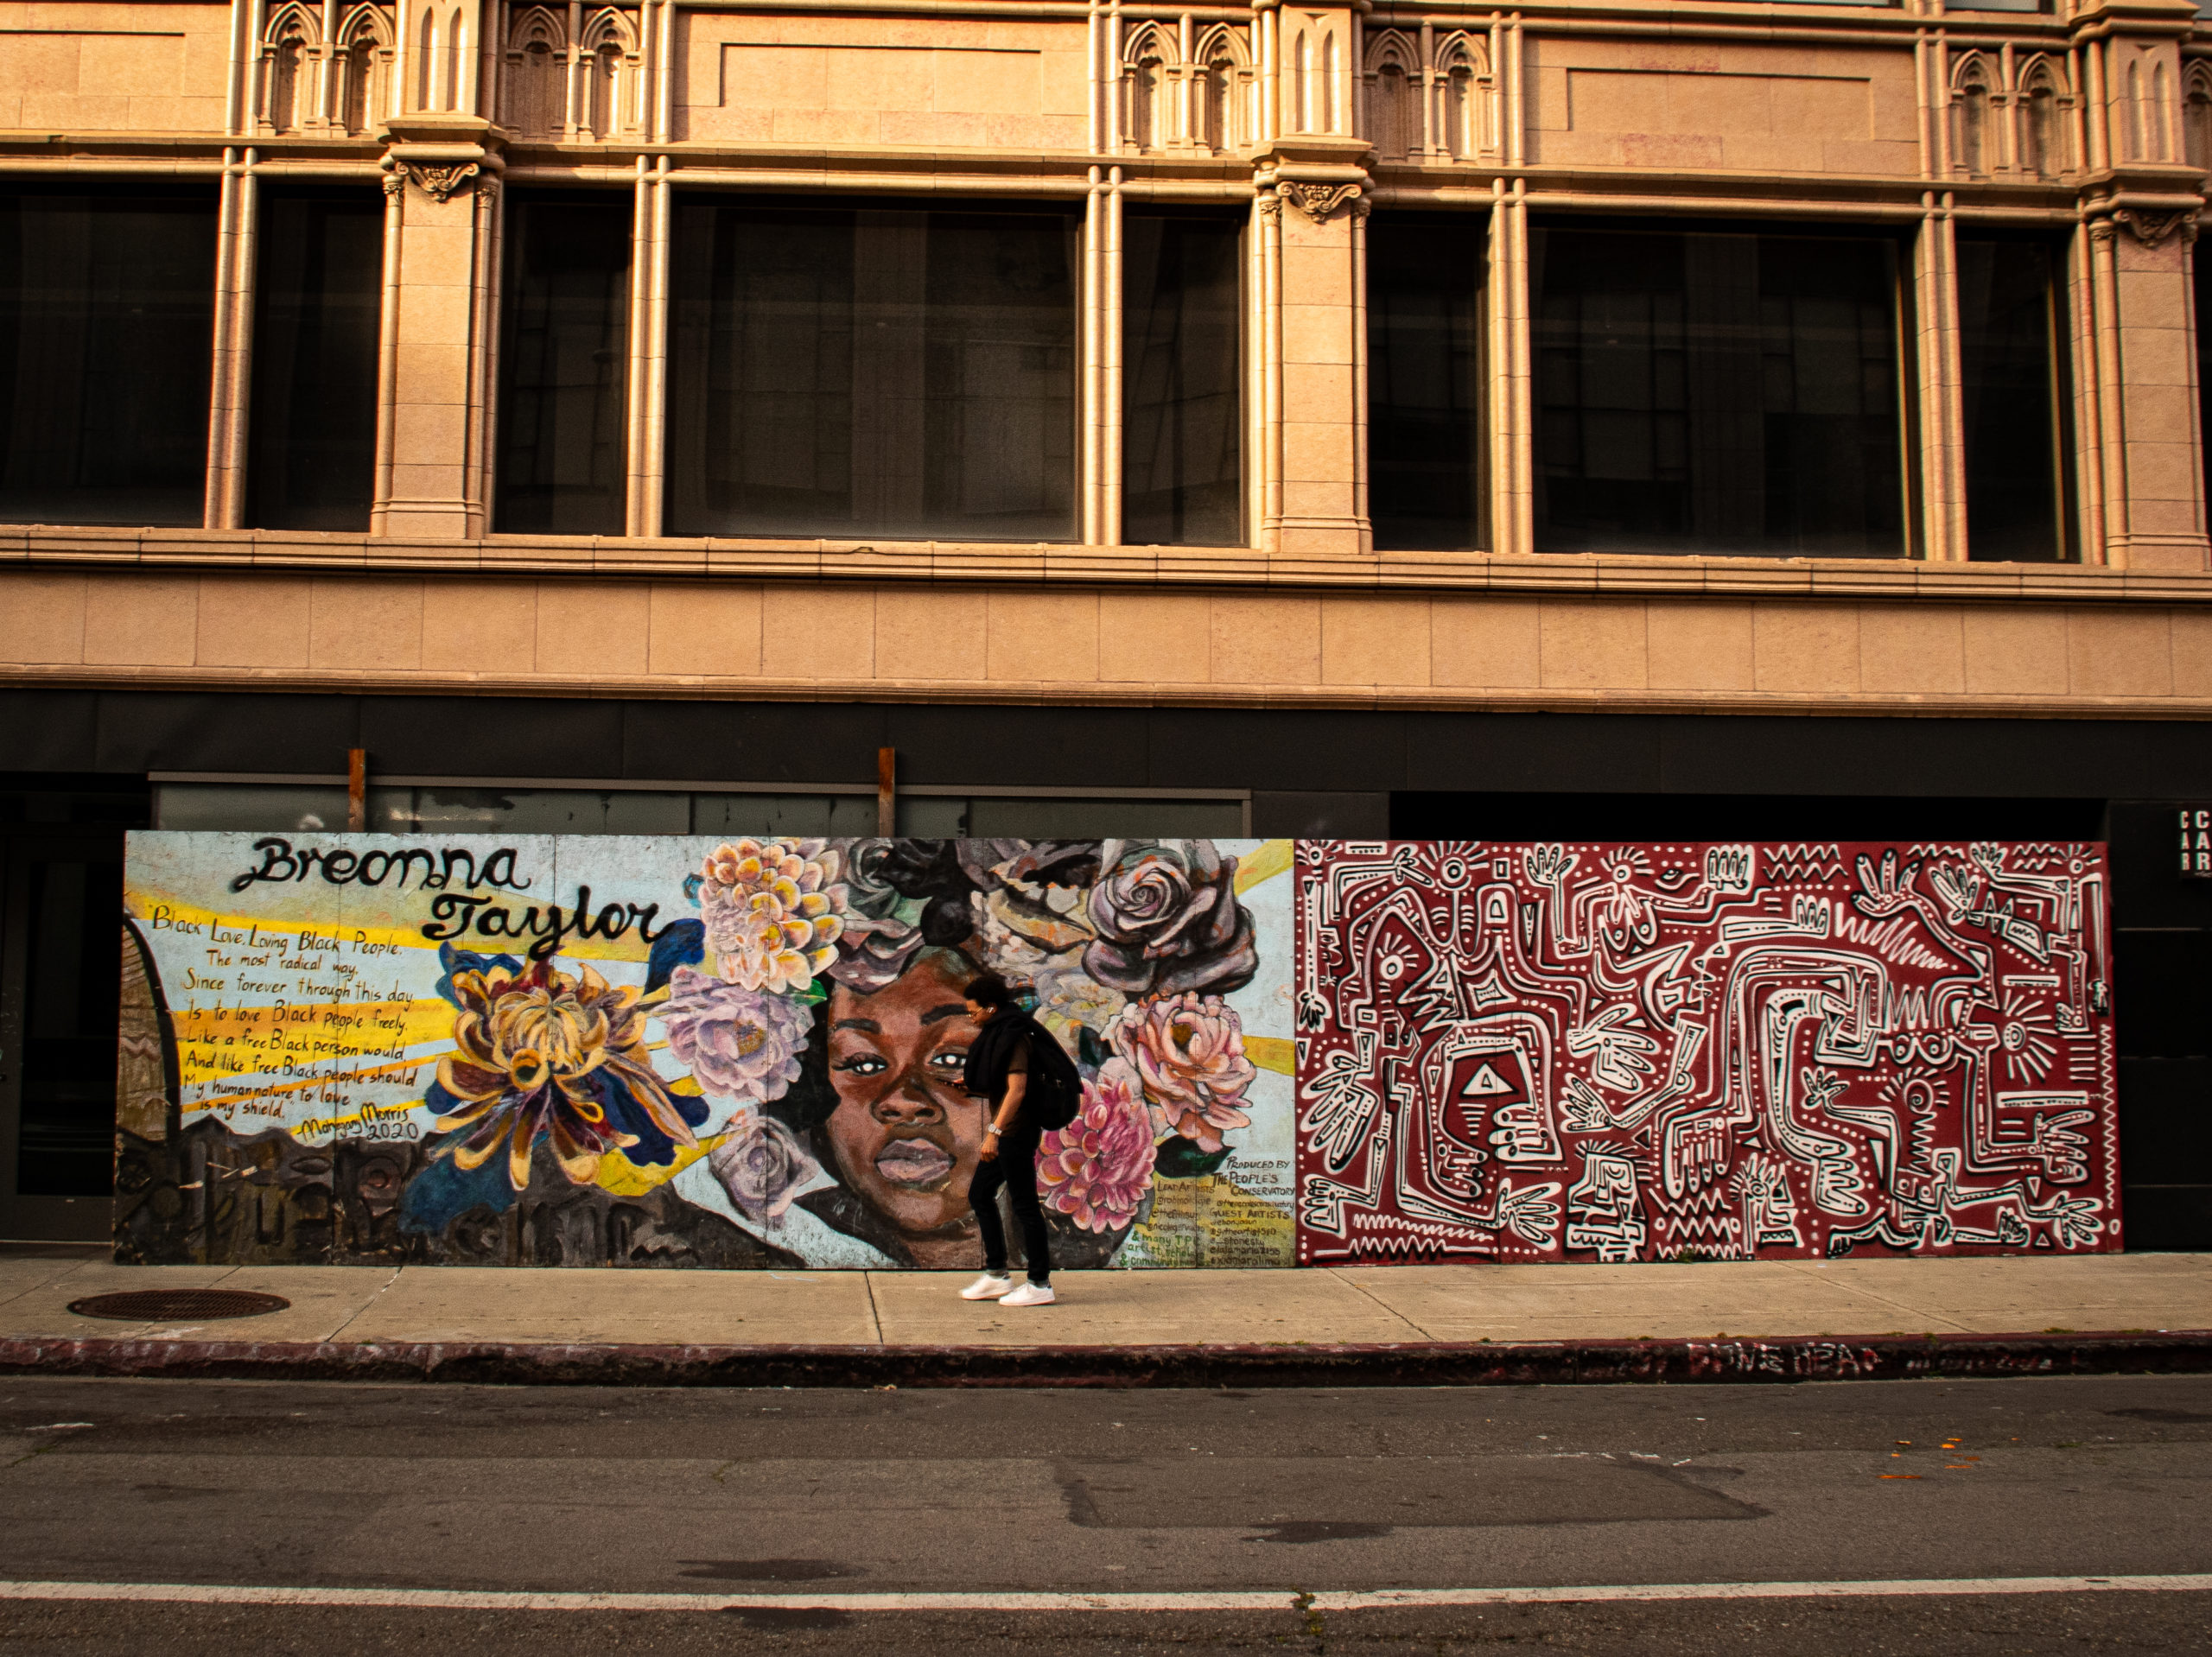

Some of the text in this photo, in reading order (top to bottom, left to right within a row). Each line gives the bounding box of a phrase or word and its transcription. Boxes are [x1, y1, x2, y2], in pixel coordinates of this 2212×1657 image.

[229, 836, 531, 893] Breonna
[421, 886, 677, 962] Taylor
[249, 924, 289, 956] Loving
[298, 930, 340, 952] Black
[353, 930, 402, 958] People.
[207, 949, 359, 981] The most radical way.
[182, 967, 225, 990] Since
[237, 972, 287, 993] forever
[298, 977, 351, 1004] through
[355, 981, 381, 1002] this
[188, 998, 202, 1020] Is
[214, 999, 227, 1020] to
[235, 999, 260, 1021] love
[272, 999, 317, 1023] Black
[324, 1009, 364, 1035] people
[188, 1025, 218, 1045] Like
[225, 1036, 235, 1045] a
[242, 1027, 268, 1048] free
[270, 1027, 309, 1051] Black
[314, 1040, 358, 1059] person
[187, 1050, 418, 1089] And like free Black people should
[184, 1073, 205, 1099] My
[300, 1085, 314, 1102] to
[320, 1084, 351, 1106] love
[200, 1101, 212, 1111] is
[217, 1102, 236, 1121] my
[359, 1101, 410, 1127] Morris
[366, 1123, 419, 1140] 2020
[1211, 1171, 1278, 1188] THE PEOPLE'S
[1275, 1159, 1290, 1169] BY
[1230, 1184, 1295, 1197] CONSERVATORY
[1210, 1208, 1290, 1220] GUEST ARTISTS
[1142, 1233, 1171, 1247] many
